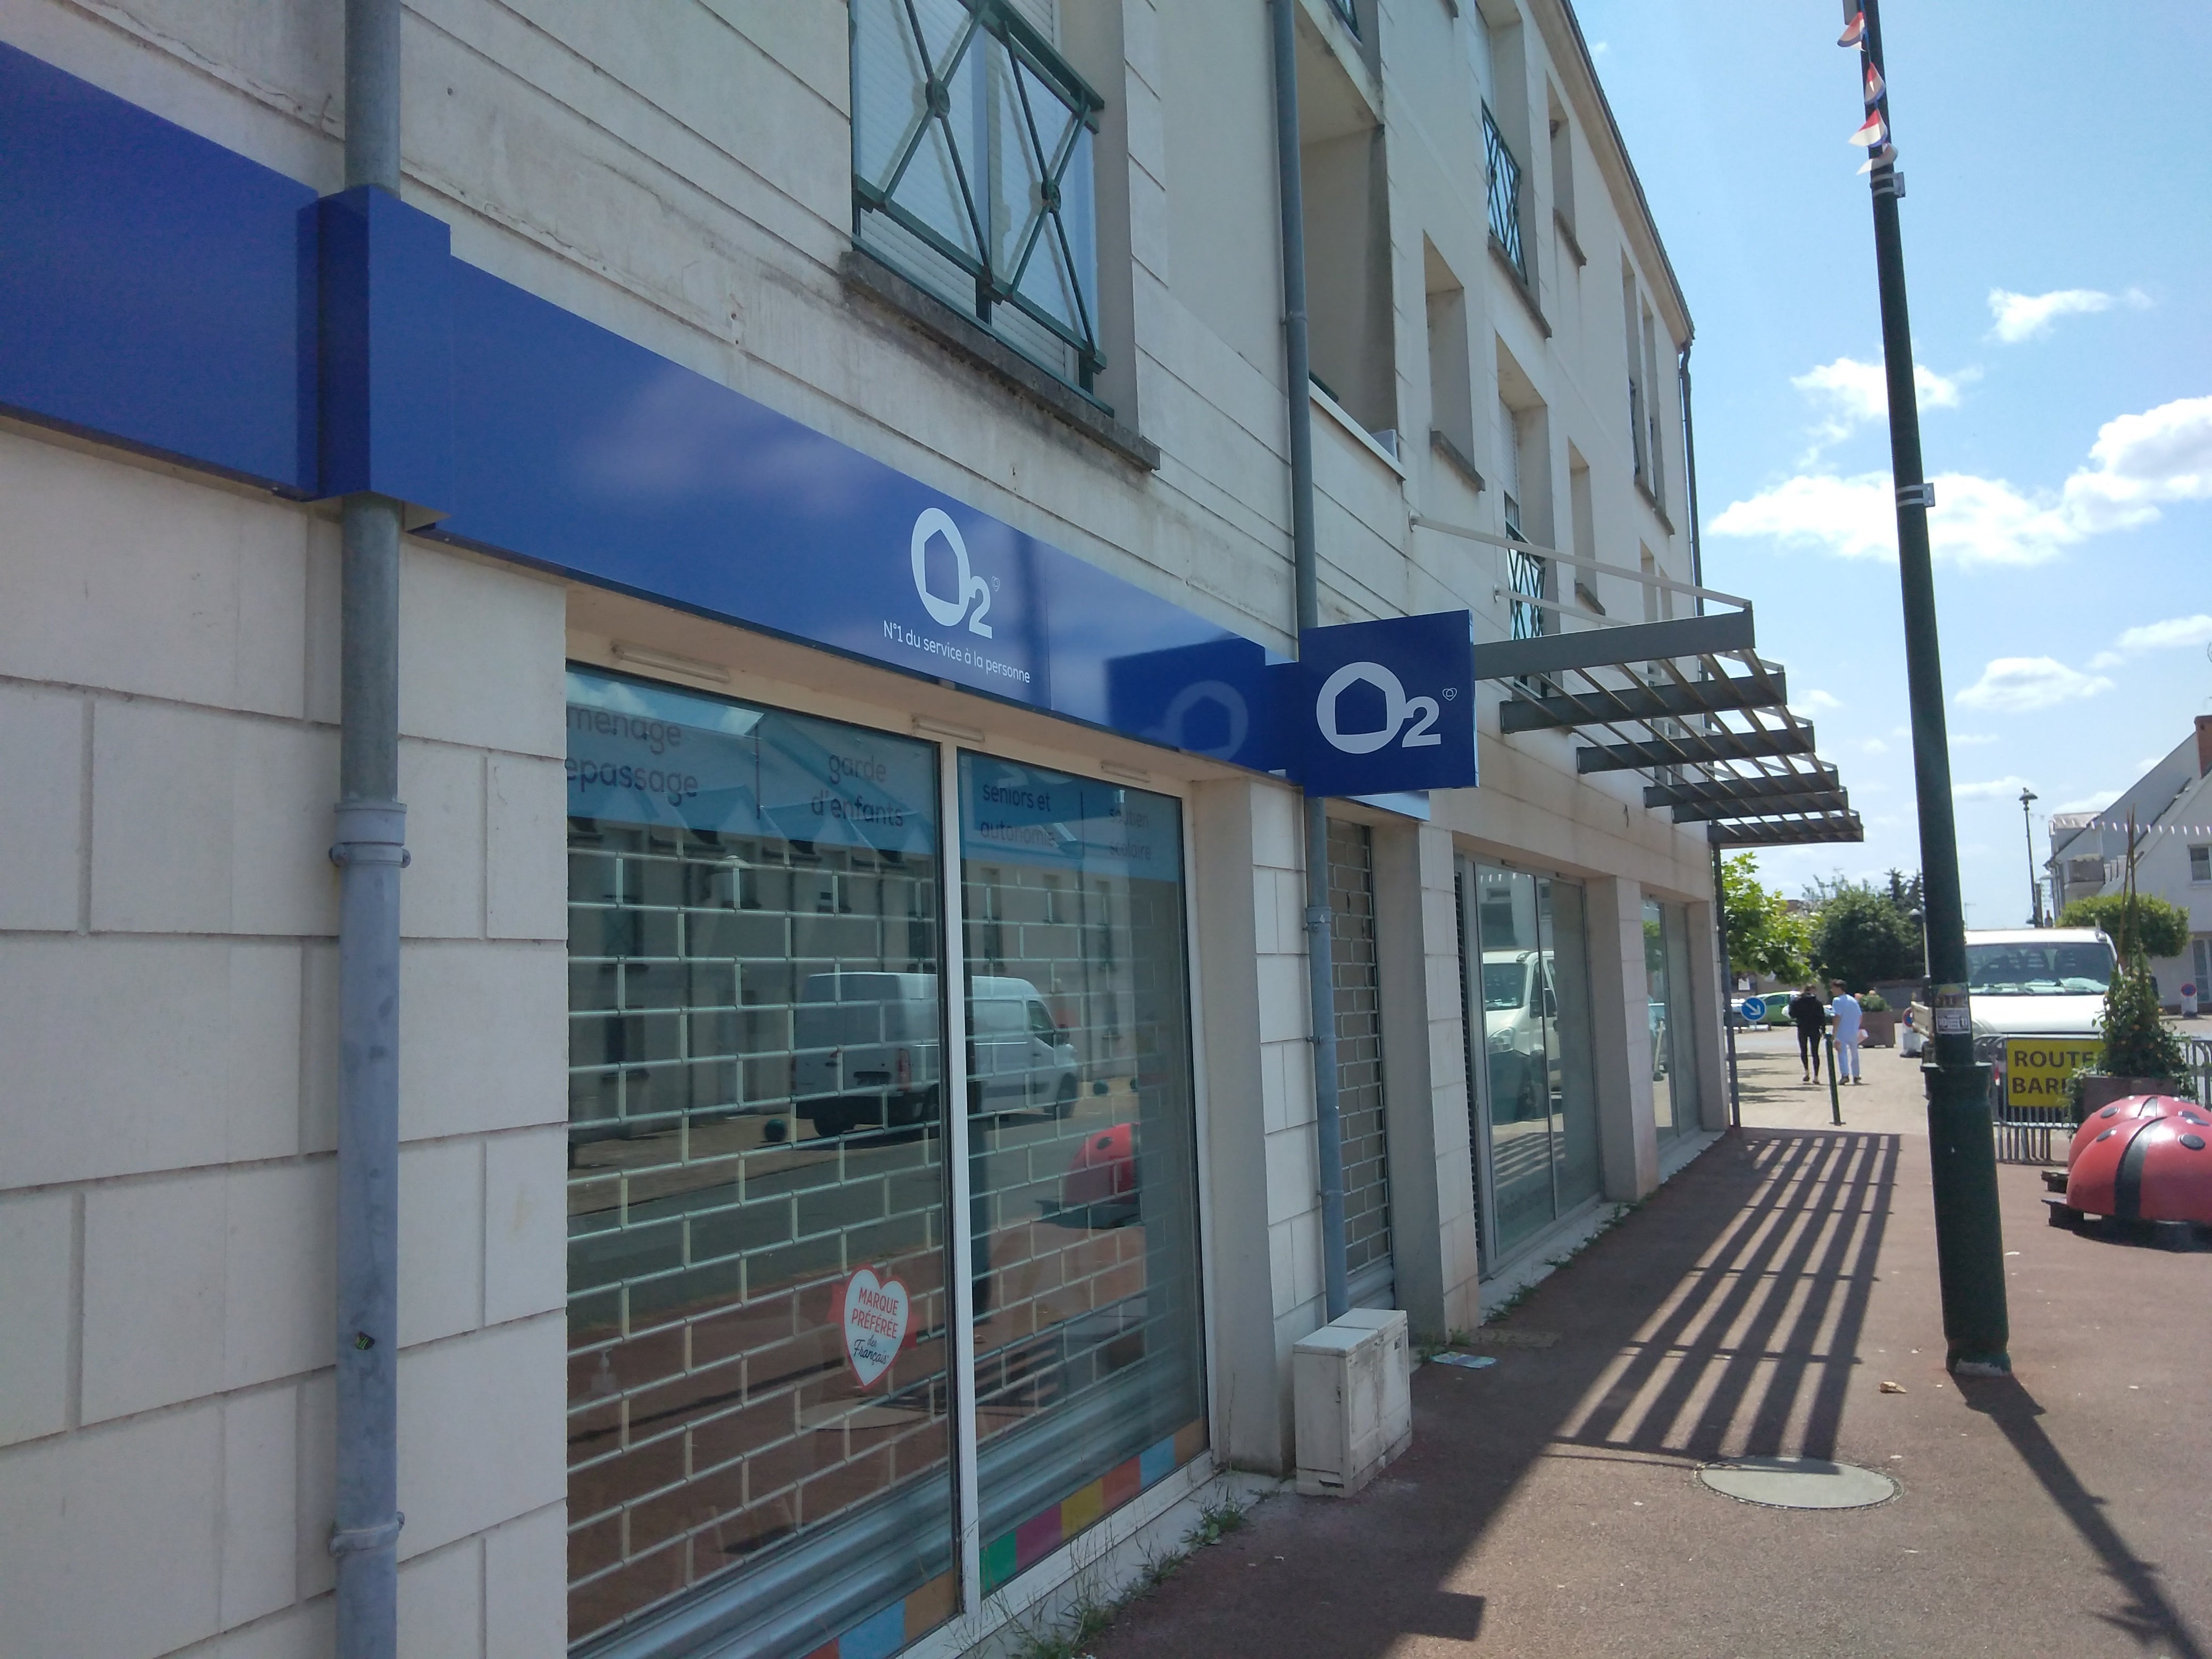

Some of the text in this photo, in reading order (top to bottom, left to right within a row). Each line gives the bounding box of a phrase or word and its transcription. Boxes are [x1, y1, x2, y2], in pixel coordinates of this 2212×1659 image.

[883, 620, 1030, 683] N°1 du service à la personne
[828, 753, 886, 785] garde
[812, 790, 903, 827] d'enfants
[983, 784, 1051, 811] seniors et
[858, 1287, 899, 1316] MARQUE
[851, 1308, 898, 1339] PRÉFÉRÉE
[867, 1334, 876, 1347] des
